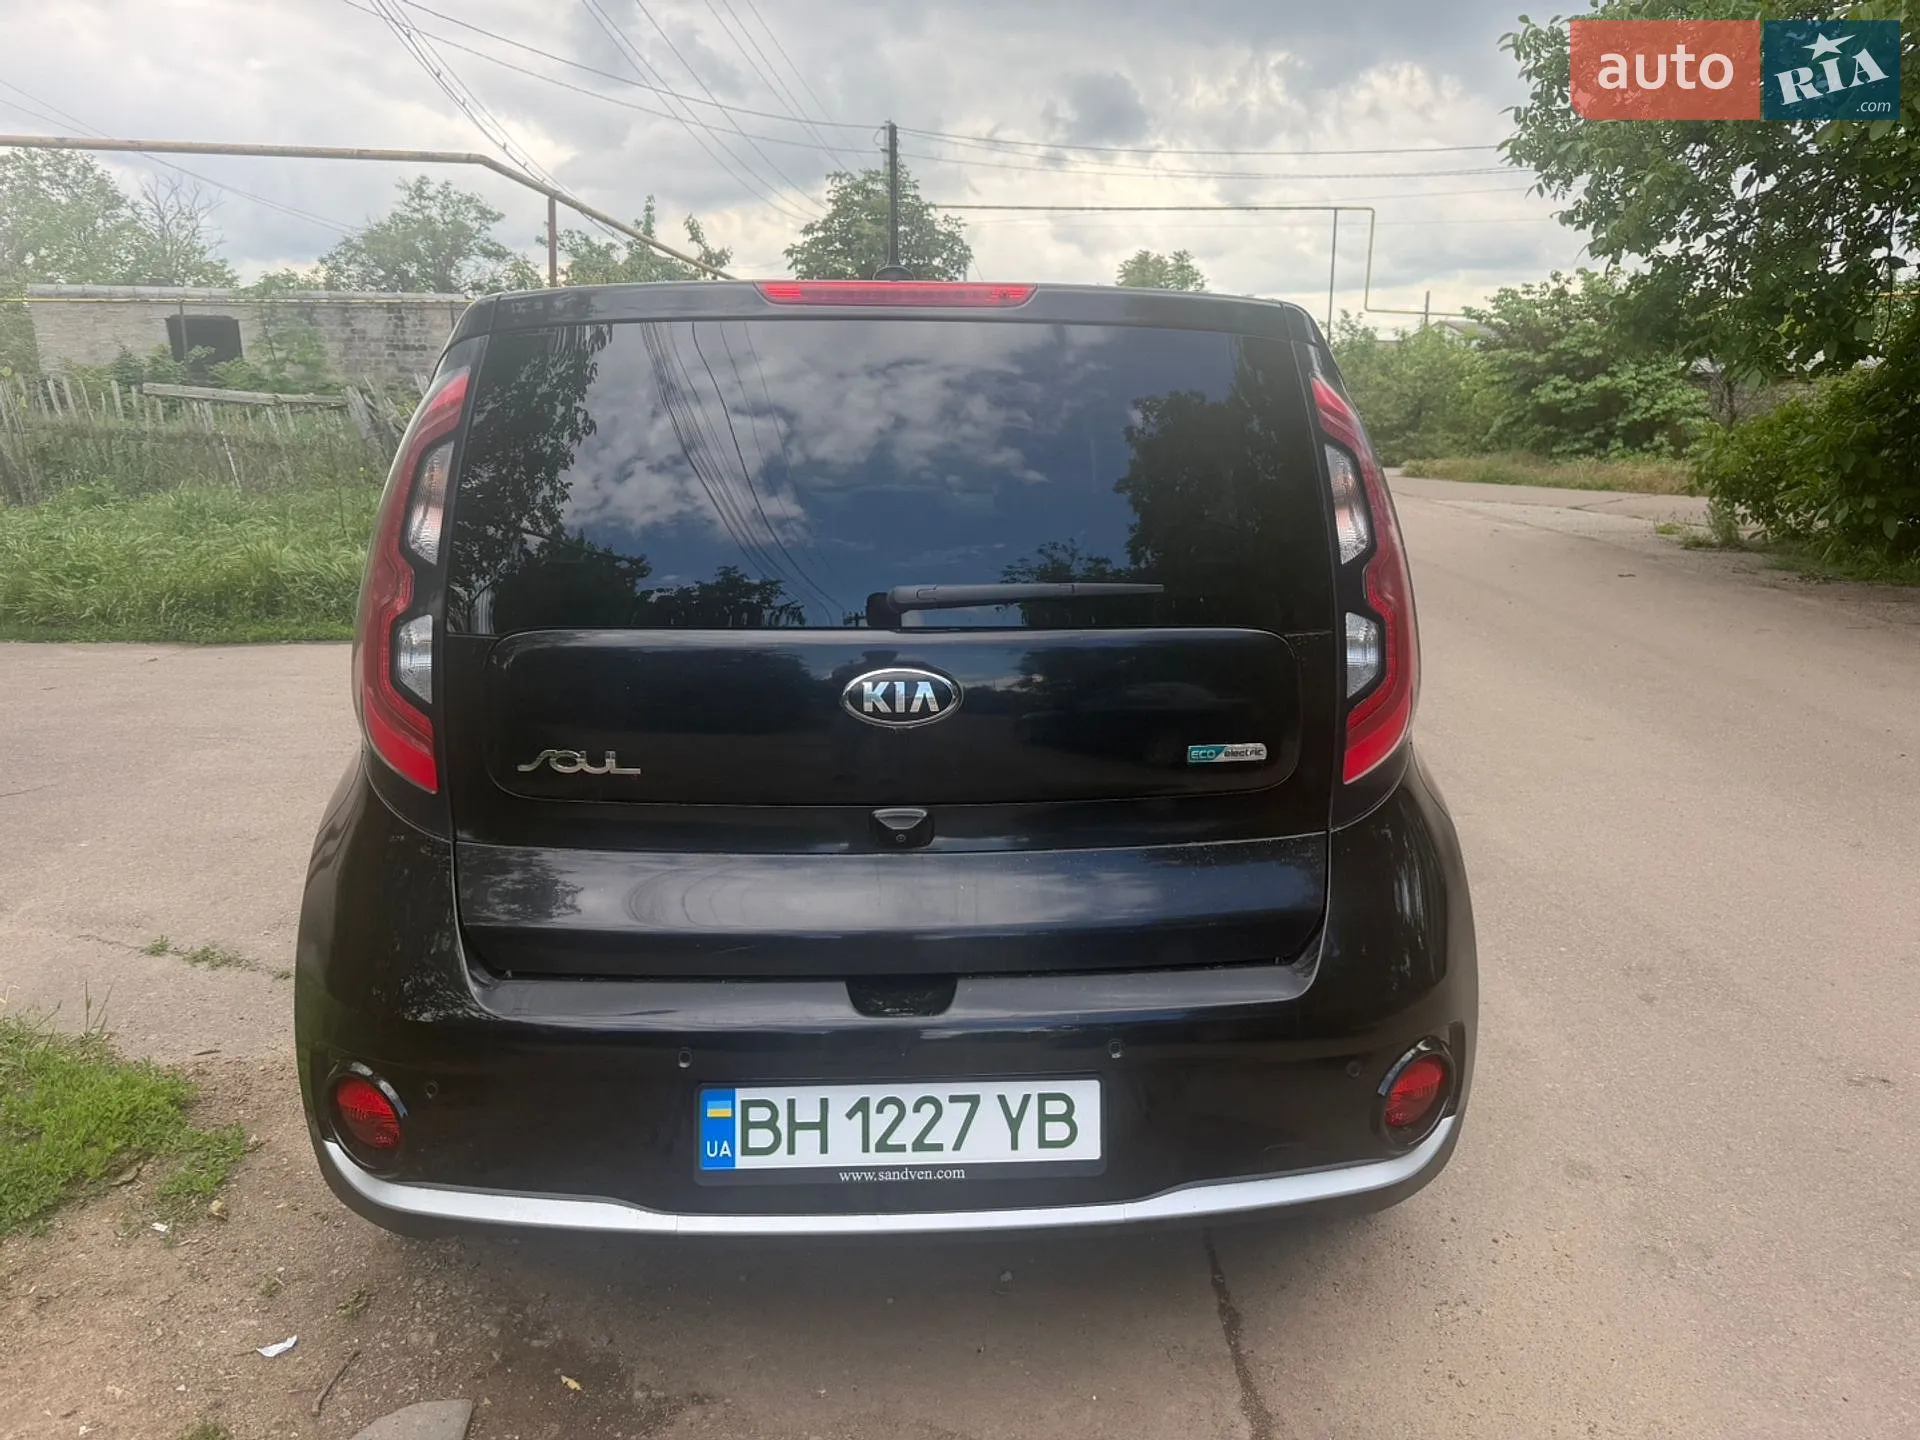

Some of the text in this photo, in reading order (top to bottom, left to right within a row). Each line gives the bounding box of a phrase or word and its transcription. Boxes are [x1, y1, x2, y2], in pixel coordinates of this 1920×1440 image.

[862, 681, 940, 713] KIA
[740, 1092, 1079, 1156] BH 1227 YB
[706, 1140, 732, 1158] UA
[838, 1167, 966, 1182] www.sandven.com
